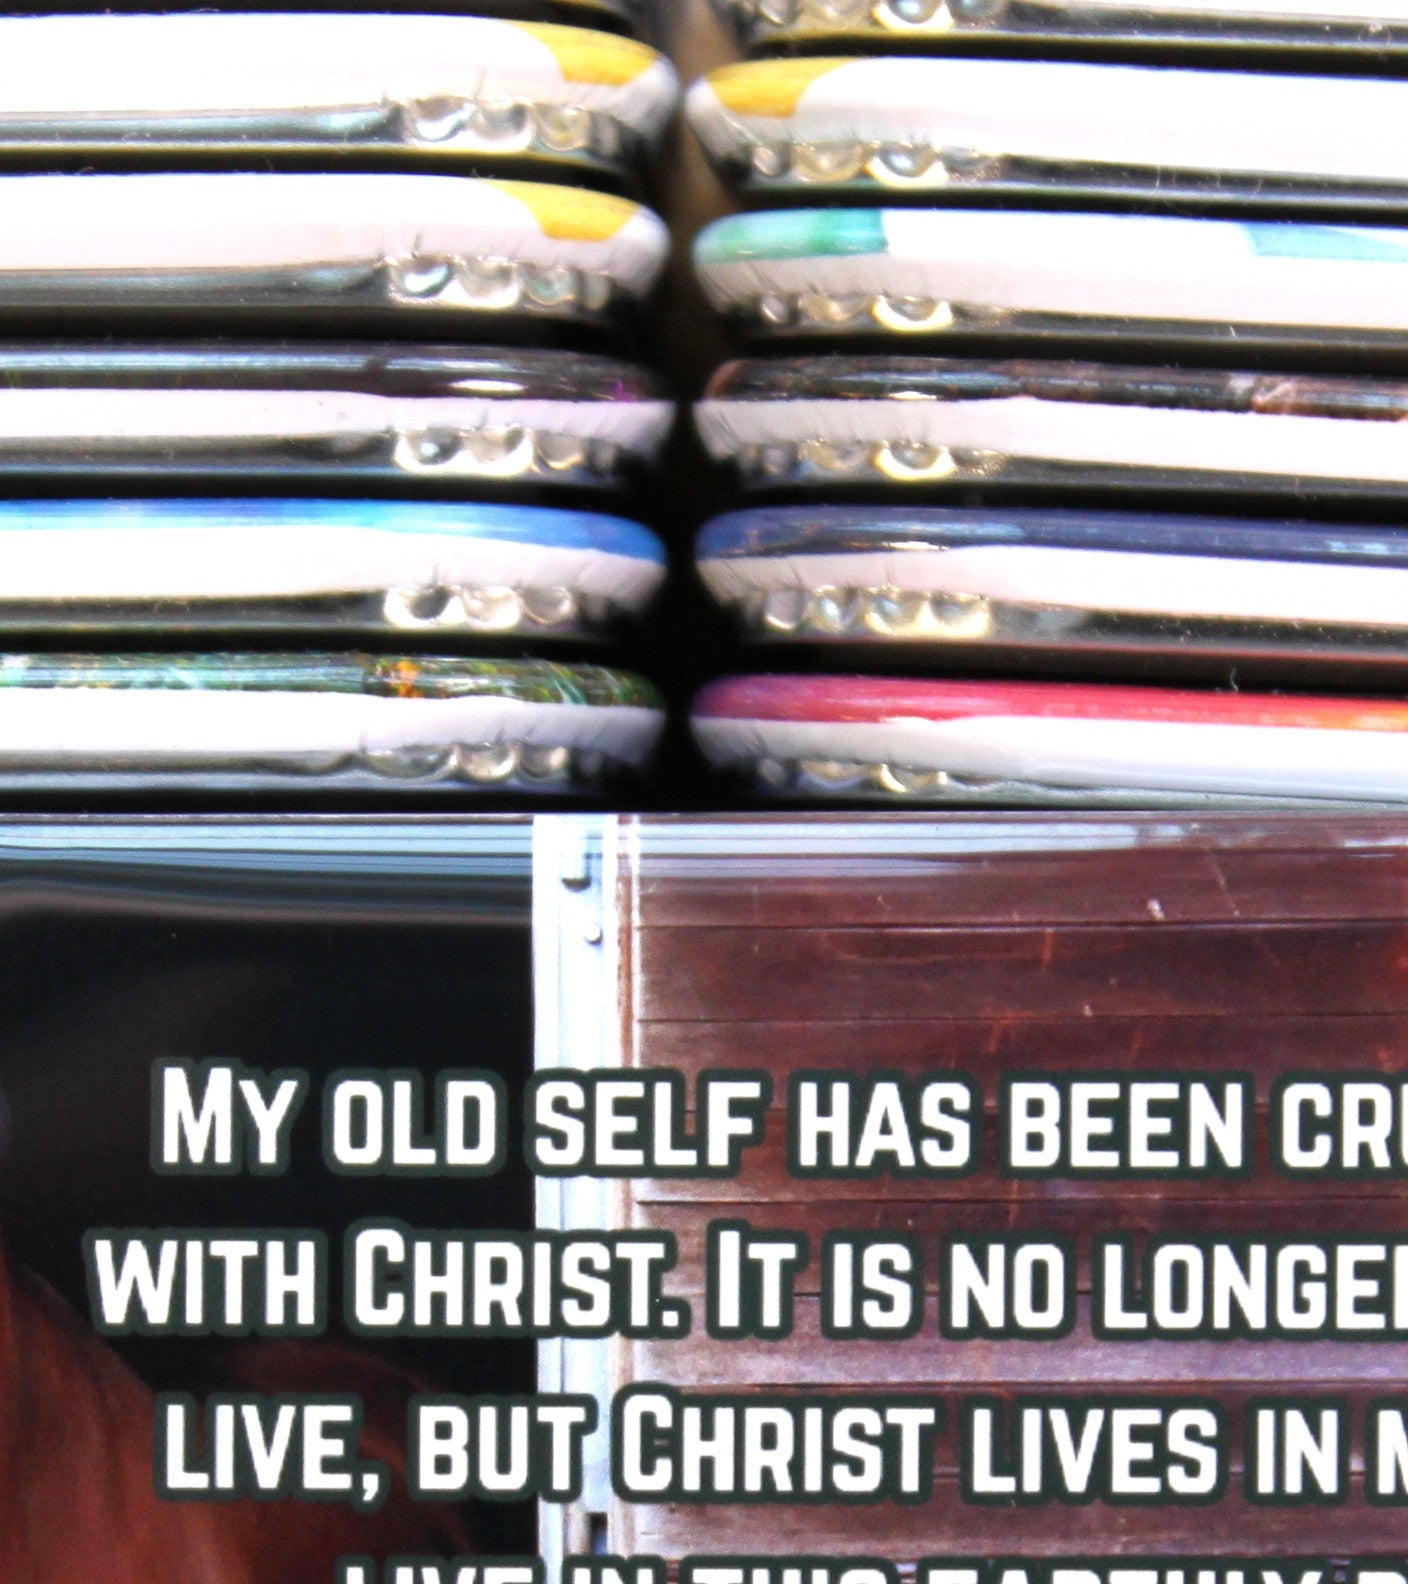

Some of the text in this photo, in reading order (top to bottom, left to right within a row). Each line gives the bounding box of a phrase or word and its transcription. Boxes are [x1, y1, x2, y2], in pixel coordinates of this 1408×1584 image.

[332, 1079, 497, 1166] OLD
[534, 1080, 761, 1167] SELF
[799, 1081, 971, 1168] HAS
[1009, 1082, 1243, 1168] BEEN
[94, 1239, 316, 1326] WITH
[832, 1242, 912, 1329] IS
[950, 1243, 1065, 1329] NO
[166, 1403, 380, 1502] LIVE,
[418, 1404, 584, 1492] BUT
[972, 1407, 1218, 1494] LIVES
[1256, 1409, 1339, 1495] IN
